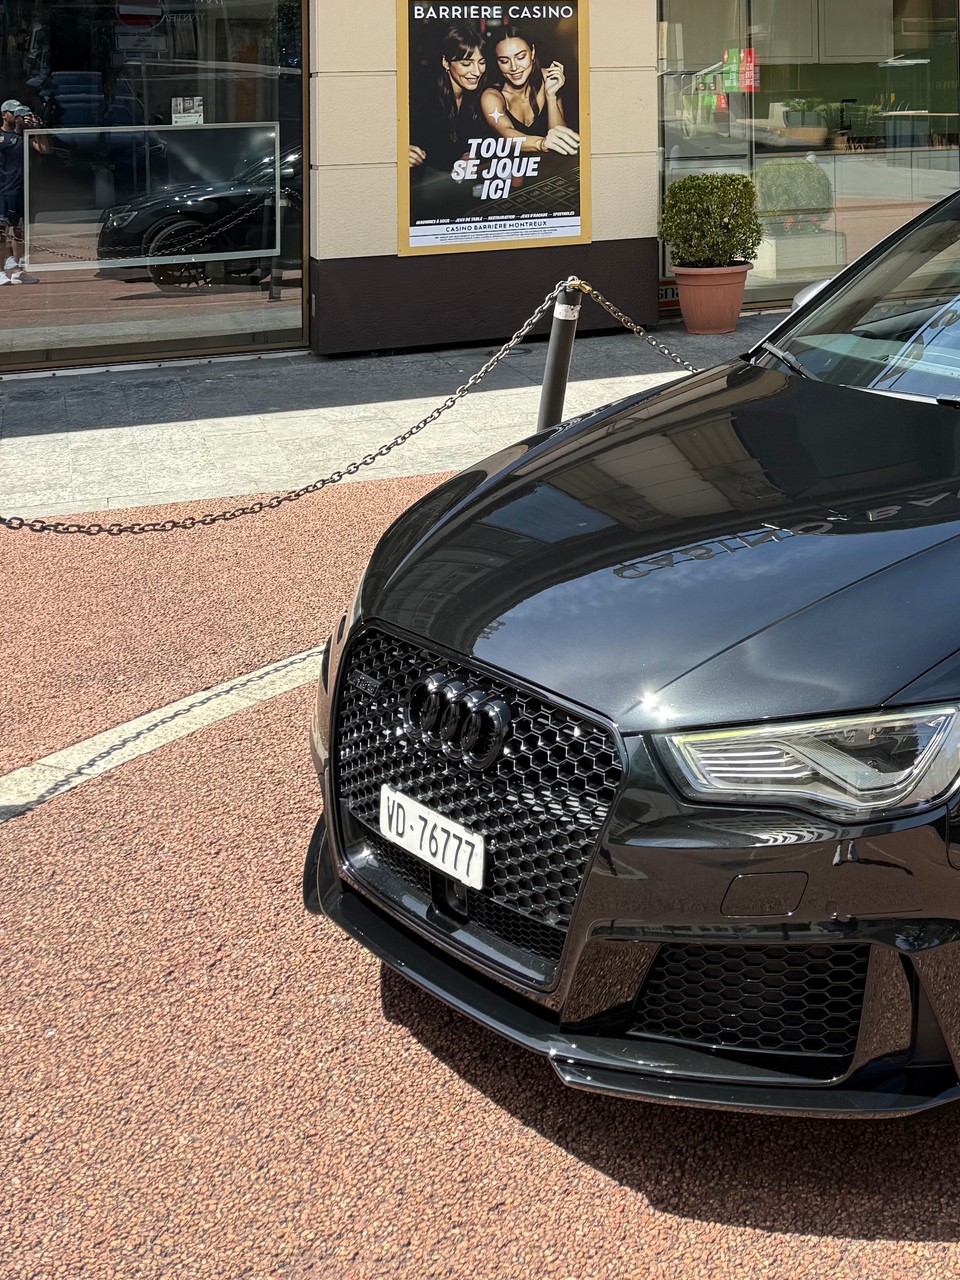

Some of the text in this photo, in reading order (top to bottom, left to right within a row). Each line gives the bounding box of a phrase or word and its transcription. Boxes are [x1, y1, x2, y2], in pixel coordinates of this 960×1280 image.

[508, 5, 574, 19] CASINO
[467, 136, 527, 158] TOUT
[451, 156, 541, 181] SE JOUE
[480, 179, 511, 200] ICI
[445, 225, 472, 233] CASINO
[509, 220, 547, 229] MONTREUX
